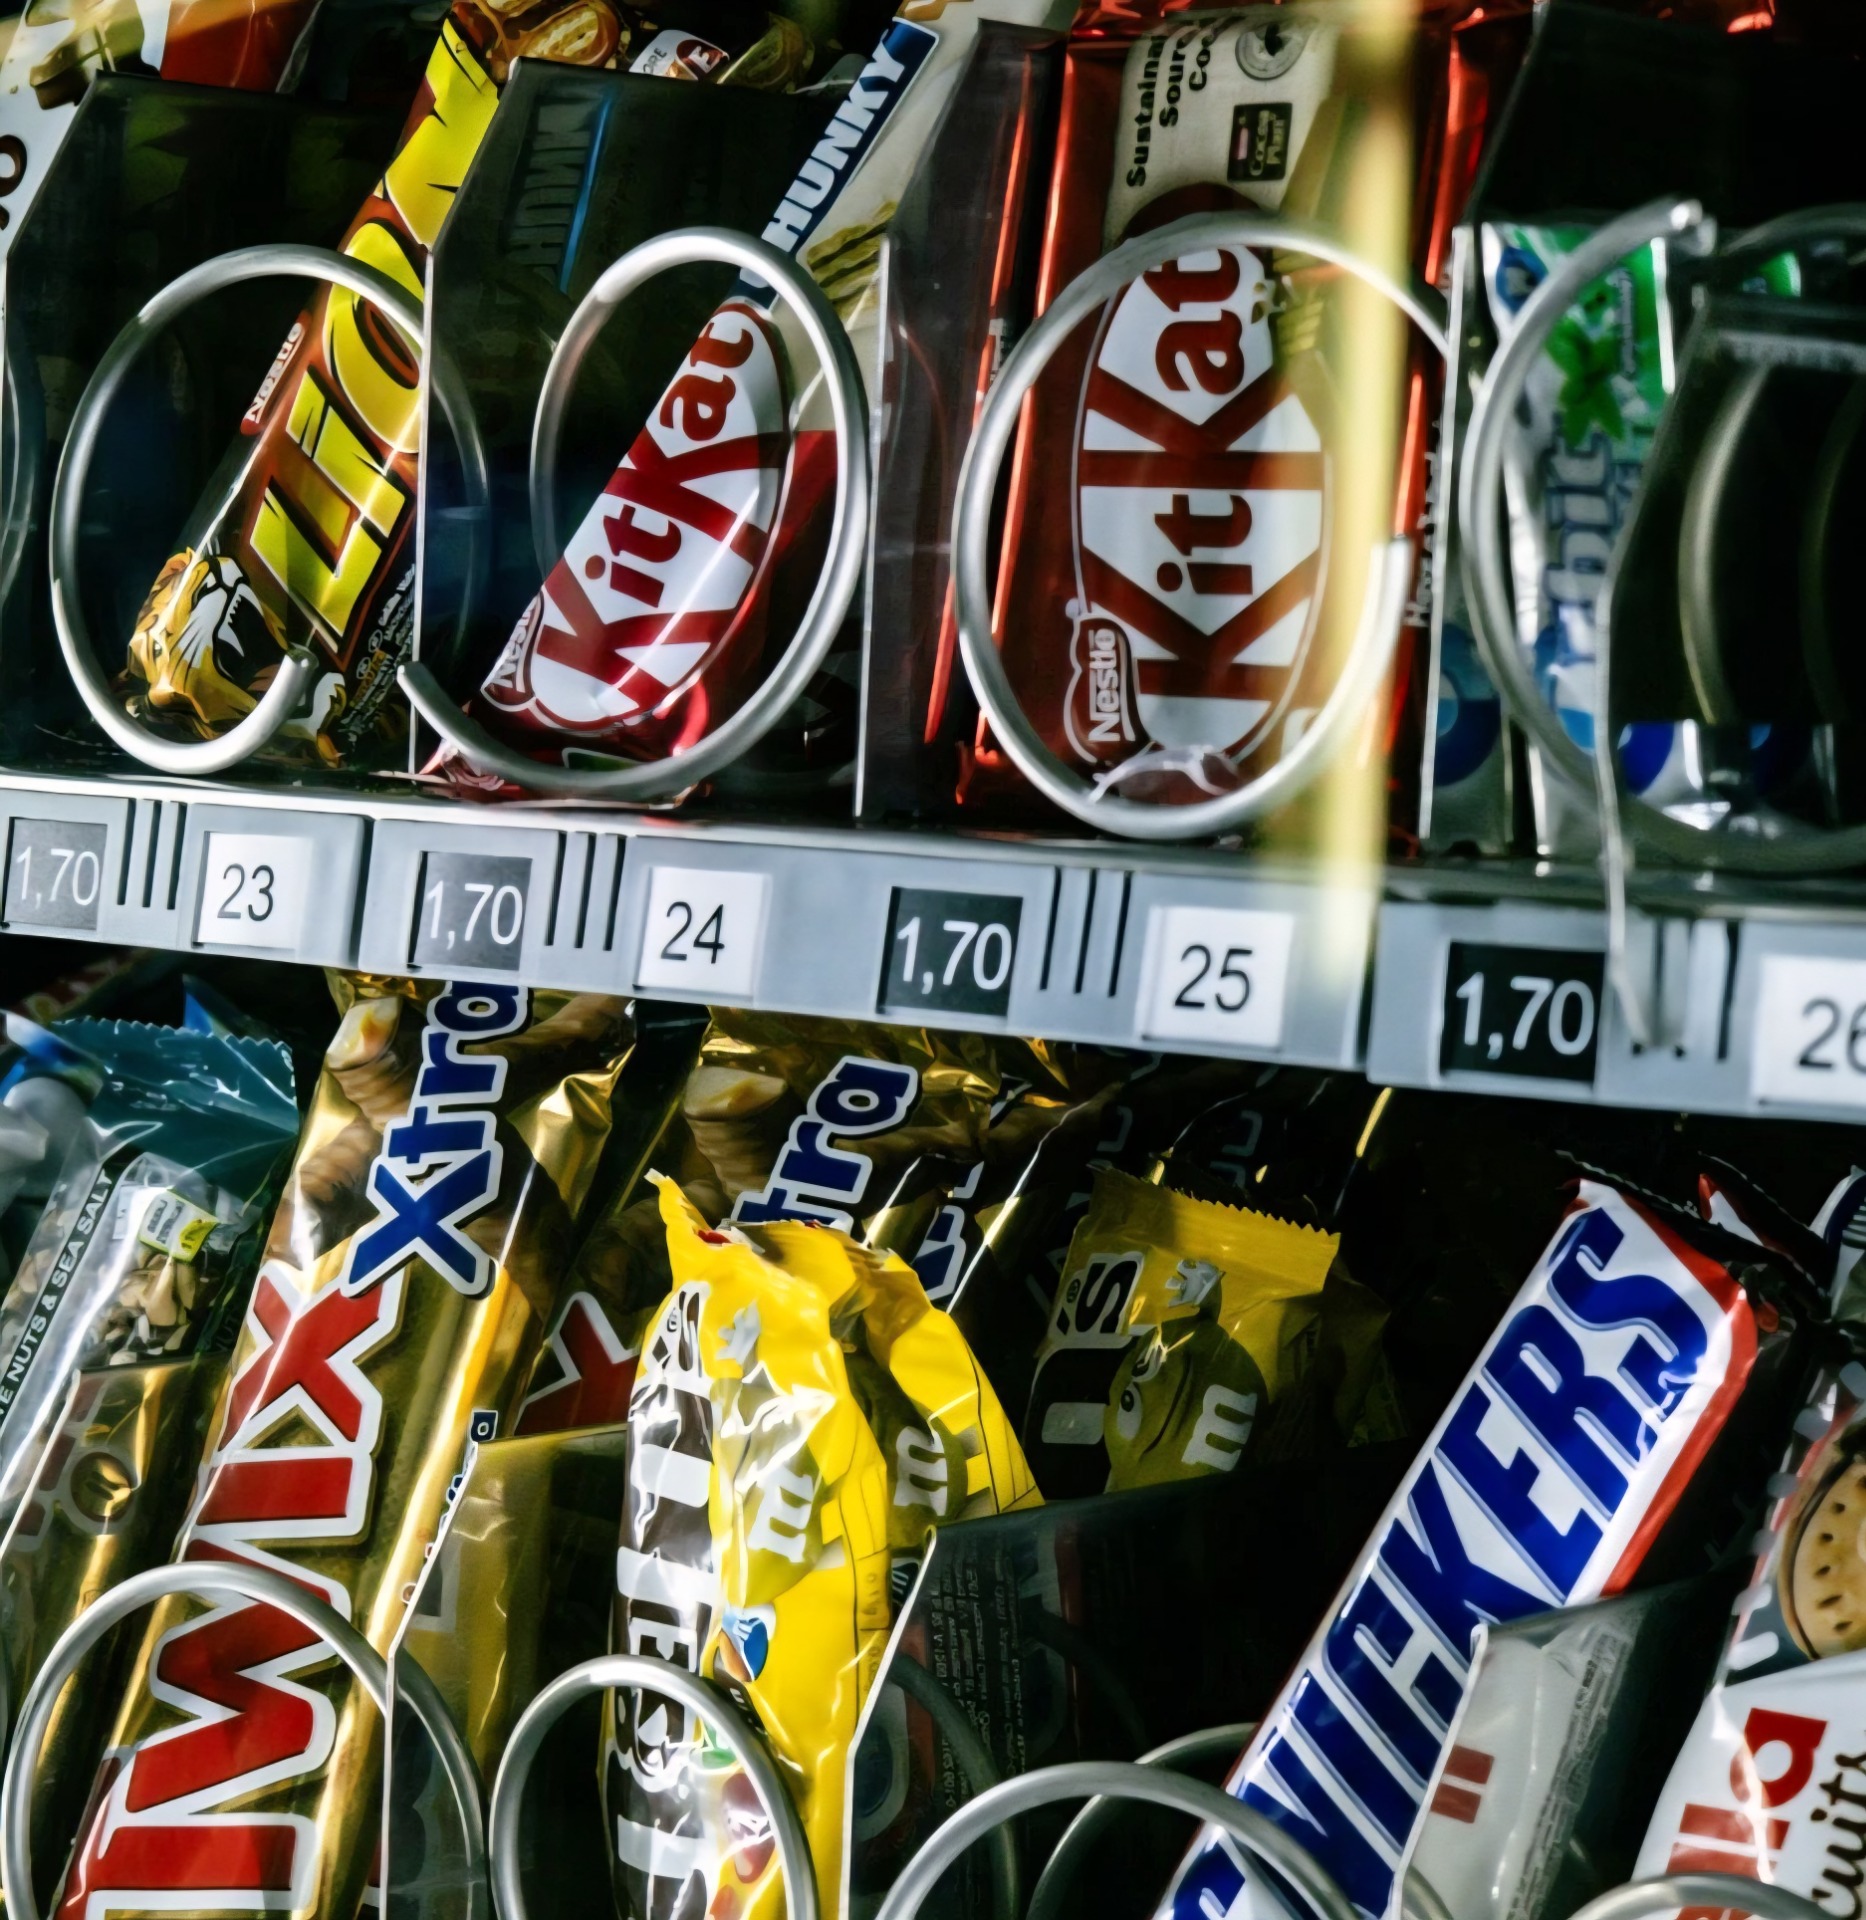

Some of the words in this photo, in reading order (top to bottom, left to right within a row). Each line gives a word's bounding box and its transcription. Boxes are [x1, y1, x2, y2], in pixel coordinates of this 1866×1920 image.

[1082, 246, 1322, 700] KitKat
[536, 321, 784, 713] KitKat
[16, 845, 101, 909] 1,70
[217, 863, 276, 922] 23
[427, 880, 523, 950] 1,70
[660, 901, 726, 964] 24
[898, 917, 1011, 992] 1,70
[1173, 944, 1254, 1011] 25
[1456, 972, 1594, 1060] 1,70
[347, 983, 526, 1286] Xtra
[7, 1316, 48, 1383] NUTS
[51, 1241, 85, 1288] SEA
[77, 1168, 113, 1235] SALT
[56, 1275, 384, 1920] TWIX
